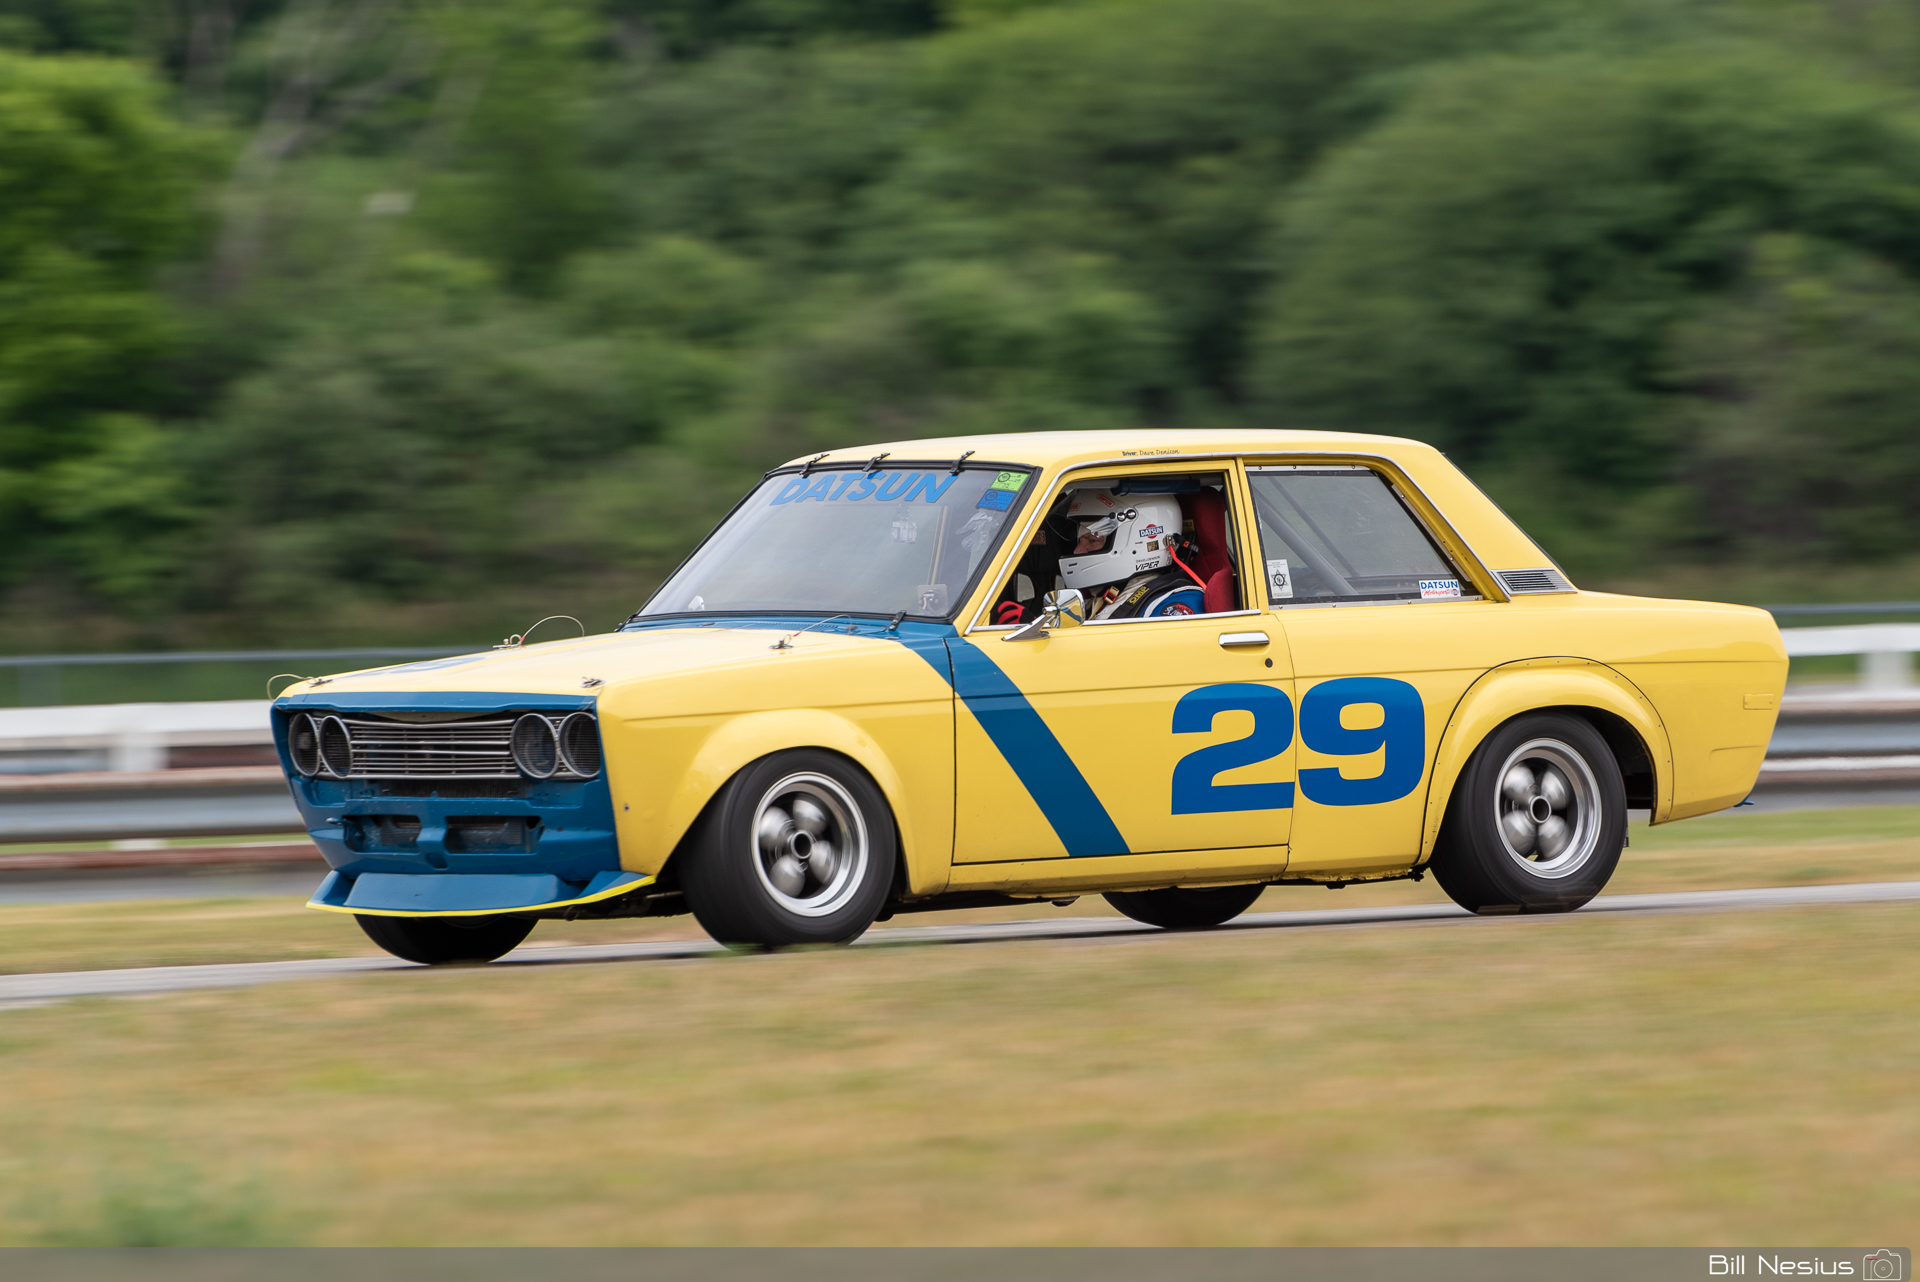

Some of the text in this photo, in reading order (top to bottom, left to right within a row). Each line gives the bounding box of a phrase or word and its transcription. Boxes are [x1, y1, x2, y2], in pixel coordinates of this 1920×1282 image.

[769, 472, 958, 506] DATSUN
[1140, 526, 1163, 537] DATSUN
[1135, 560, 1159, 571] VIPER
[1420, 580, 1458, 589] DATSUN
[1128, 586, 1150, 604] OMP
[1171, 677, 1425, 815] 29
